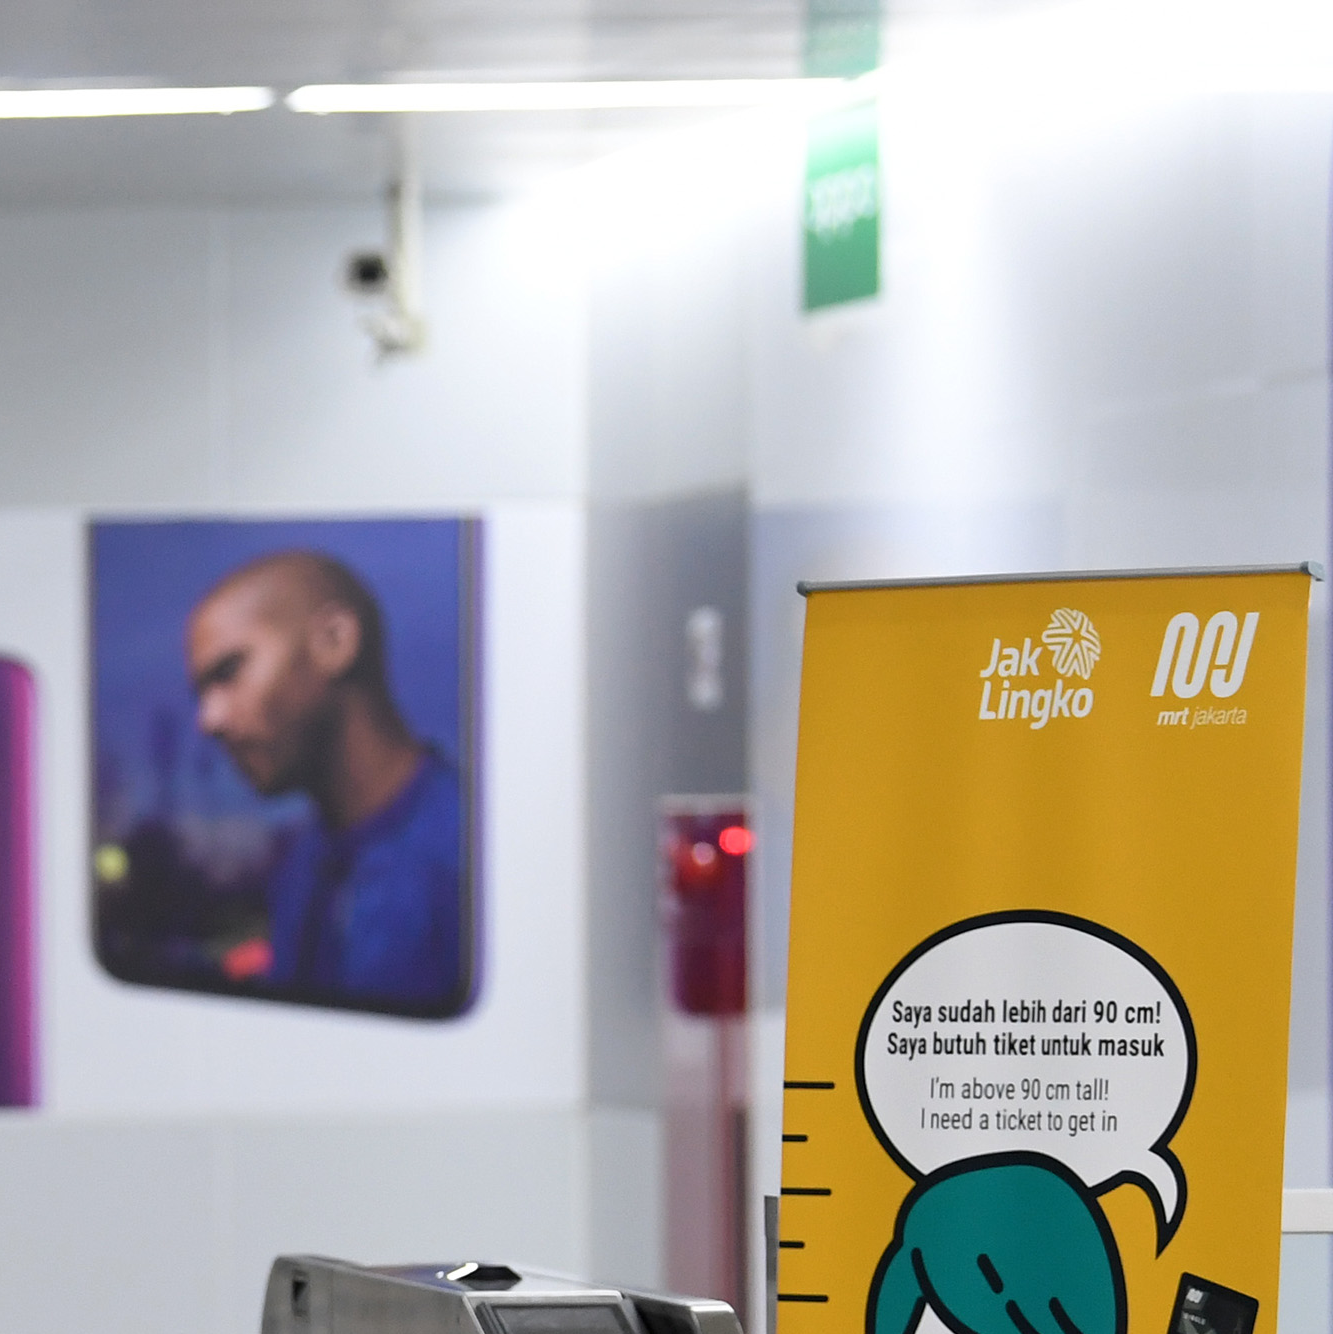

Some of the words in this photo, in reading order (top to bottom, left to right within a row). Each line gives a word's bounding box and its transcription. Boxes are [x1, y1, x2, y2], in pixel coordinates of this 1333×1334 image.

[979, 637, 1043, 678] Jak
[978, 678, 1094, 730] Lingko
[1157, 707, 1190, 726] mrt
[1190, 706, 1248, 730] jakarta
[892, 999, 932, 1029] Saya
[938, 998, 995, 1023] sudah
[1002, 998, 1047, 1023] lebih
[1052, 998, 1086, 1023] dari
[1093, 1000, 1117, 1024] 90
[1125, 1000, 1161, 1024] cm!
[887, 1031, 927, 1061] Saya
[933, 1030, 986, 1055] butuh
[993, 1031, 1036, 1056] tiket
[1041, 1032, 1092, 1056] untuk
[1098, 1032, 1165, 1057] masuk
[930, 1077, 955, 1100] I'm
[961, 1077, 1016, 1100] above
[1020, 1078, 1041, 1101] 90
[1045, 1083, 1070, 1101] cm
[1075, 1077, 1109, 1101] tall!
[921, 1107, 925, 1129] I
[930, 1107, 973, 1130] need
[979, 1112, 989, 1130] a
[995, 1108, 1042, 1131] ticket
[1047, 1110, 1063, 1131] to
[1068, 1111, 1095, 1137] get
[1101, 1110, 1118, 1132] in
